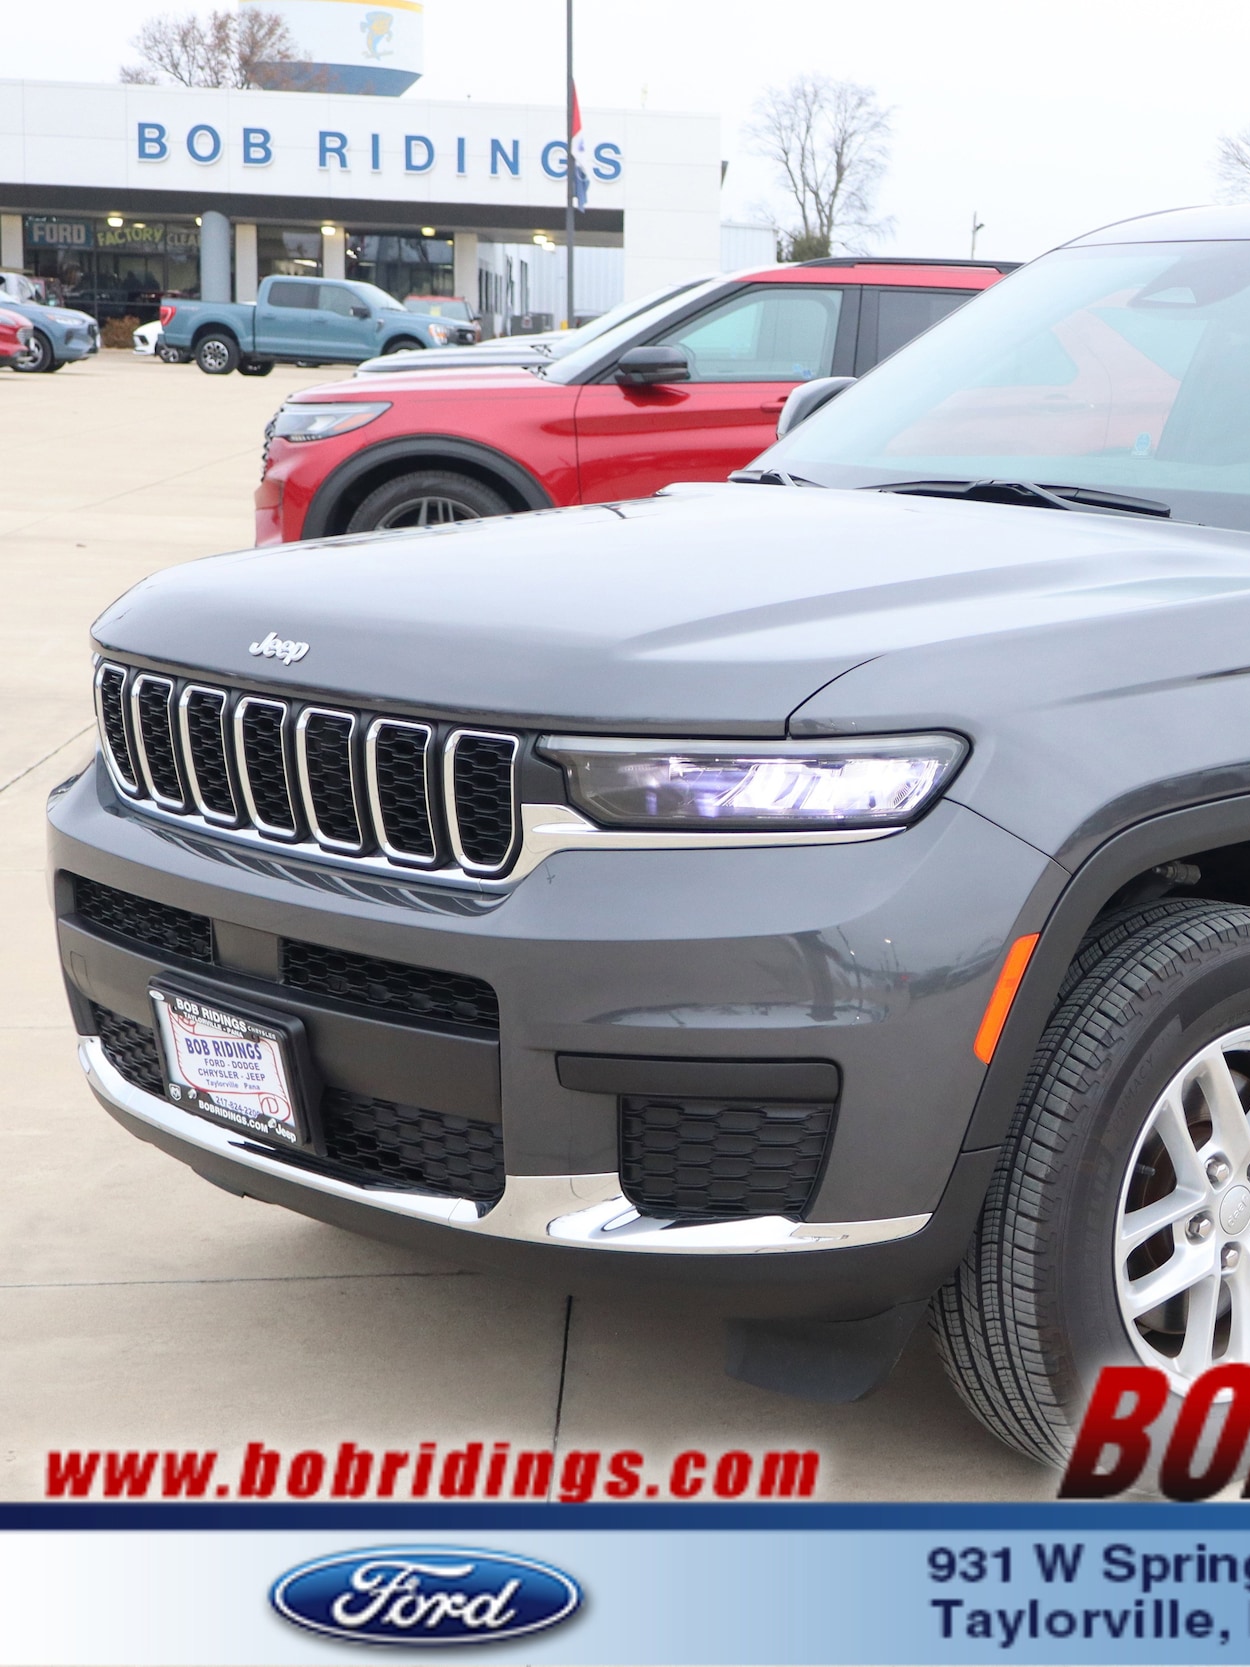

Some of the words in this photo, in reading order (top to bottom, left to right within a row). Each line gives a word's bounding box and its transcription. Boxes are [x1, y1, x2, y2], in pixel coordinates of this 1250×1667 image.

[137, 122, 273, 165] BOB
[318, 131, 623, 181] RIDINGS
[33, 223, 86, 244] FORD
[97, 227, 164, 247] FACTORY
[167, 231, 201, 246] CLEA
[248, 631, 310, 666] Jeep
[175, 998, 199, 1016] BOB
[201, 1006, 247, 1032] RIDINGS
[185, 1038, 210, 1056] BOB
[212, 1040, 262, 1060] RIDINGS
[198, 1068, 239, 1080] CHRYSLER
[245, 1072, 266, 1082] JEEP
[204, 1058, 226, 1068] FORD
[232, 1061, 260, 1071] DODGE
[206, 1079, 239, 1090] Taylorville
[243, 1082, 261, 1091] Pana
[198, 1100, 269, 1134] BOBRIDINGS.COM
[275, 1123, 297, 1143] Jeep
